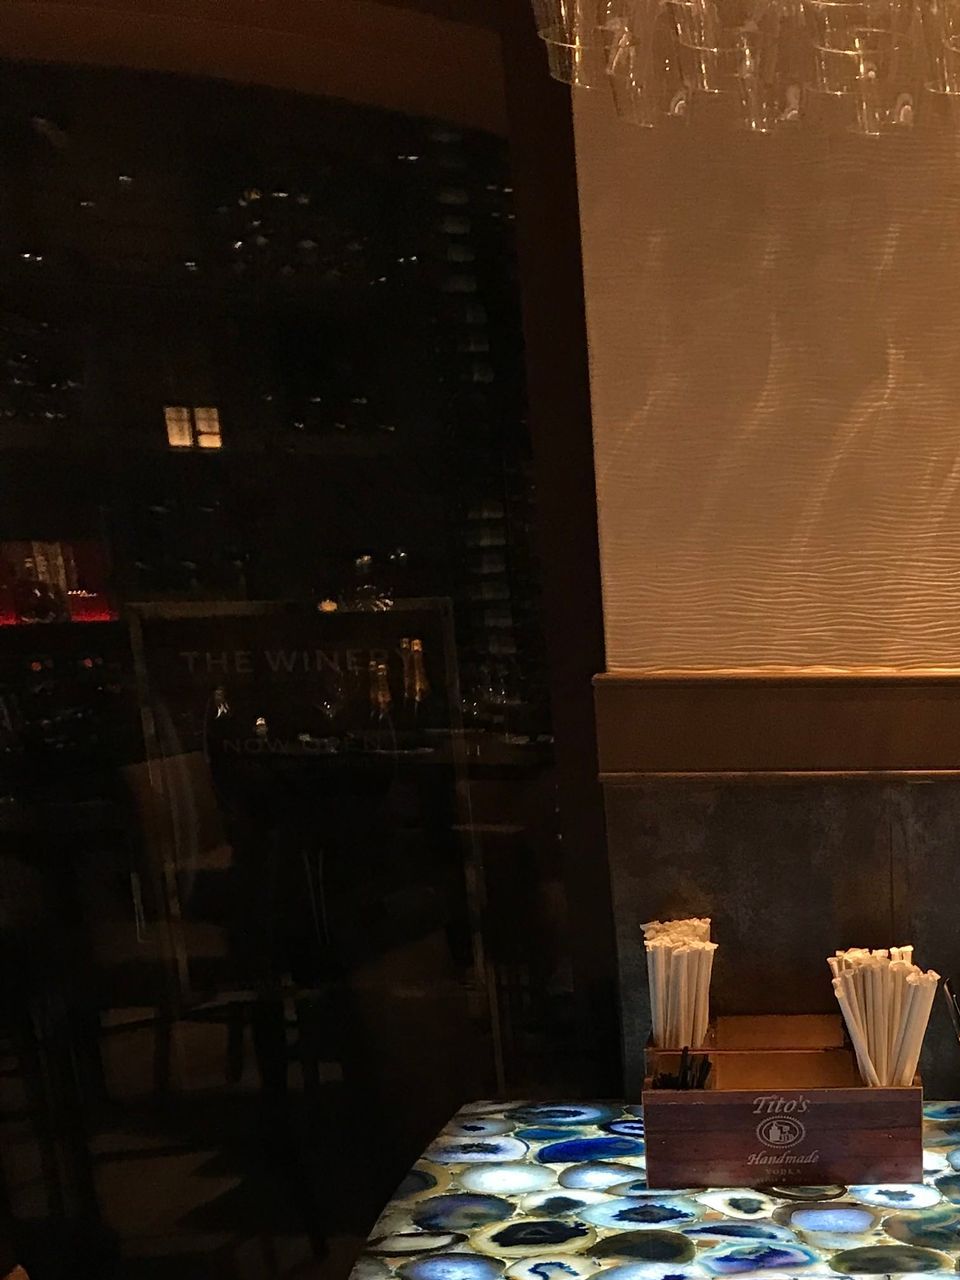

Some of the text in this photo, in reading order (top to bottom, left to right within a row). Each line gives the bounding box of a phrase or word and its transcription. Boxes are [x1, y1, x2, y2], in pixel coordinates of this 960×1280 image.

[179, 650, 254, 673] THE
[222, 737, 289, 754] NOW
[752, 1094, 811, 1114] Tito's
[746, 1149, 820, 1165] Handmade
[765, 1168, 802, 1176] VODKA
